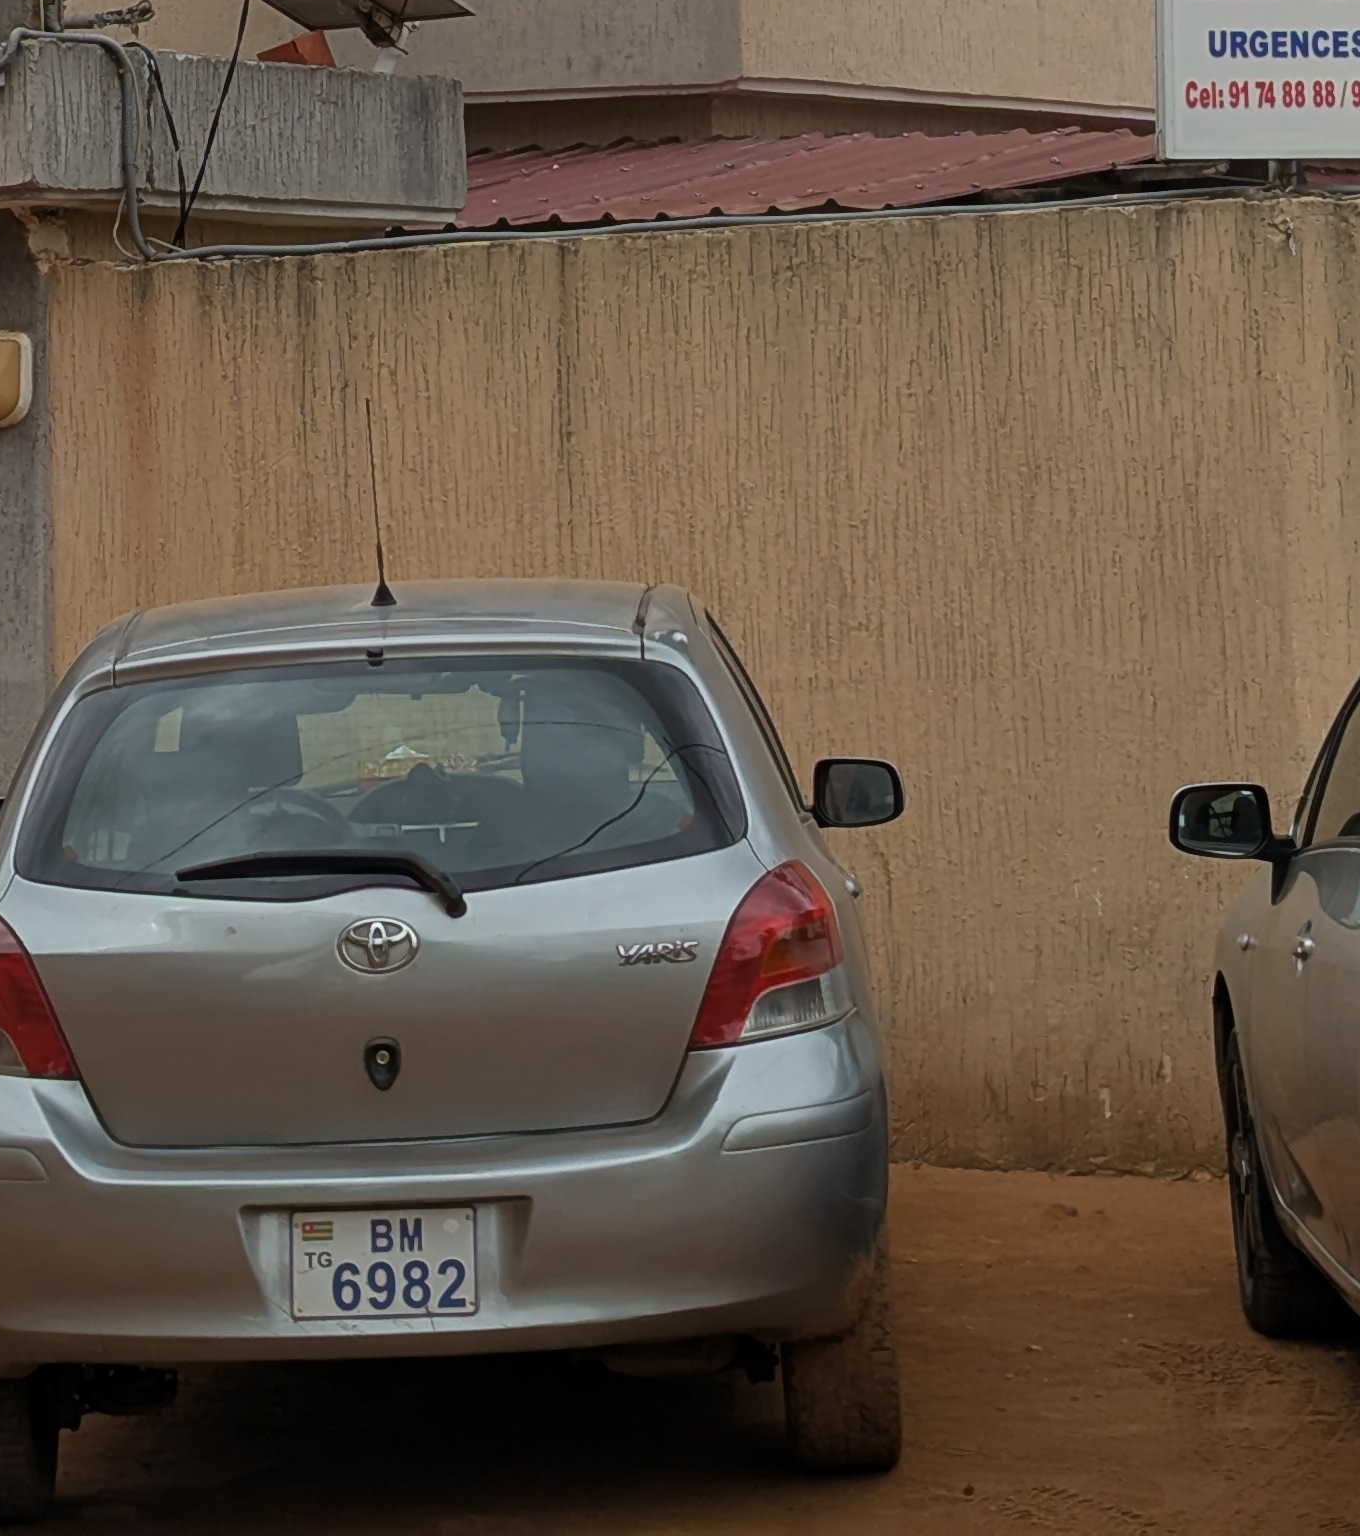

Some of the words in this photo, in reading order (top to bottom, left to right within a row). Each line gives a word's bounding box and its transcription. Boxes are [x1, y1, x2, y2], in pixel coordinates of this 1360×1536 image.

[1185, 80, 1224, 108] Cel:
[1228, 80, 1249, 108] 91
[1255, 81, 1276, 108] 74
[1282, 81, 1306, 108] 88
[1312, 80, 1336, 108] 88
[371, 1217, 423, 1253] BM
[304, 1251, 333, 1269] TG
[332, 1258, 467, 1311] 6982
